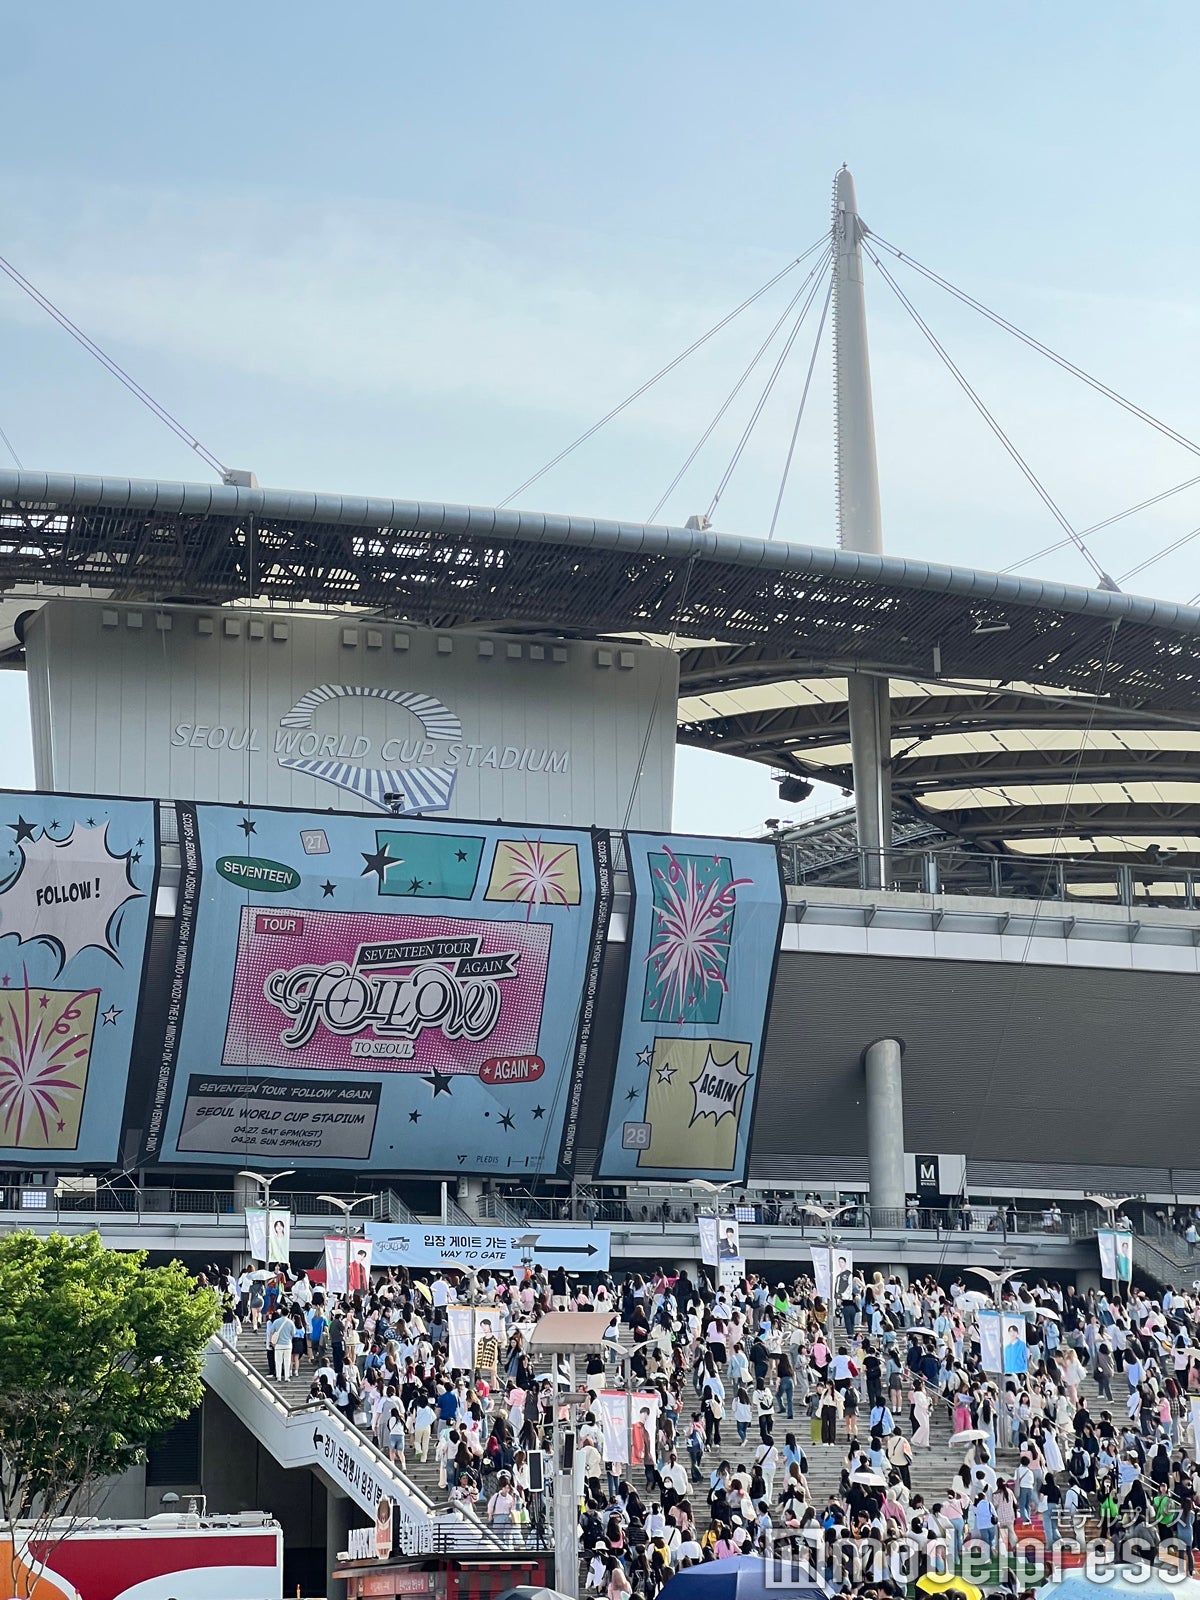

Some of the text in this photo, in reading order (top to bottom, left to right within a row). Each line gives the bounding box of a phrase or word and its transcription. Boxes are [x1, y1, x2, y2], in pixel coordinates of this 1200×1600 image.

[171, 723, 570, 774] SEOUL WORLD CUP STADIUM
[306, 835, 321, 849] 27
[185, 840, 198, 871] JEONGHAN
[223, 861, 293, 885] SEVENTEEN
[183, 874, 196, 900] JOSHUA
[182, 902, 193, 918] JUN
[179, 920, 191, 942] HOSHI
[262, 919, 297, 931] TOUR
[174, 945, 188, 976] WONWOO
[364, 942, 471, 961] SEVENTEEN TOUR
[462, 959, 504, 973] AGAIN
[587, 967, 599, 995] WONWOO
[171, 981, 184, 1001] WOOZI
[267, 965, 498, 1044] FOLLOW
[584, 1000, 594, 1019] WOOZI
[164, 1025, 177, 1050] MINGYU
[162, 1052, 173, 1062] DK
[355, 1042, 411, 1055] TO SEOUL
[578, 1044, 588, 1066] MINGYU
[494, 1059, 529, 1080] AGAIN
[576, 1070, 584, 1079] DK
[154, 1065, 171, 1104] SEUNGKWAN
[199, 1083, 259, 1094] SEVENTEEN
[261, 1086, 286, 1096] TOUR
[338, 1089, 373, 1099] AGAIN
[699, 1073, 738, 1102] AGAIN
[570, 1083, 582, 1119] SEUNGKWAN
[149, 1108, 163, 1133] VERNON
[196, 1107, 366, 1124] SEOUL WORLD CUP STADIUM
[261, 1128, 279, 1136] SAT
[280, 1129, 322, 1138] 6PM(KST)
[566, 1123, 577, 1147] VERNON
[626, 1128, 647, 1144] 28
[145, 1137, 158, 1152] DINO
[259, 1138, 278, 1146] SUN
[279, 1139, 322, 1148] 5PM(KST)
[476, 1156, 499, 1164] PLEDIS
[563, 1150, 573, 1165] DINO
[920, 1164, 935, 1179] M
[424, 1235, 445, 1248] 입장
[450, 1235, 482, 1248] 게이트
[485, 1236, 507, 1249] 가는
[440, 1250, 507, 1260] WAY TO GATE
